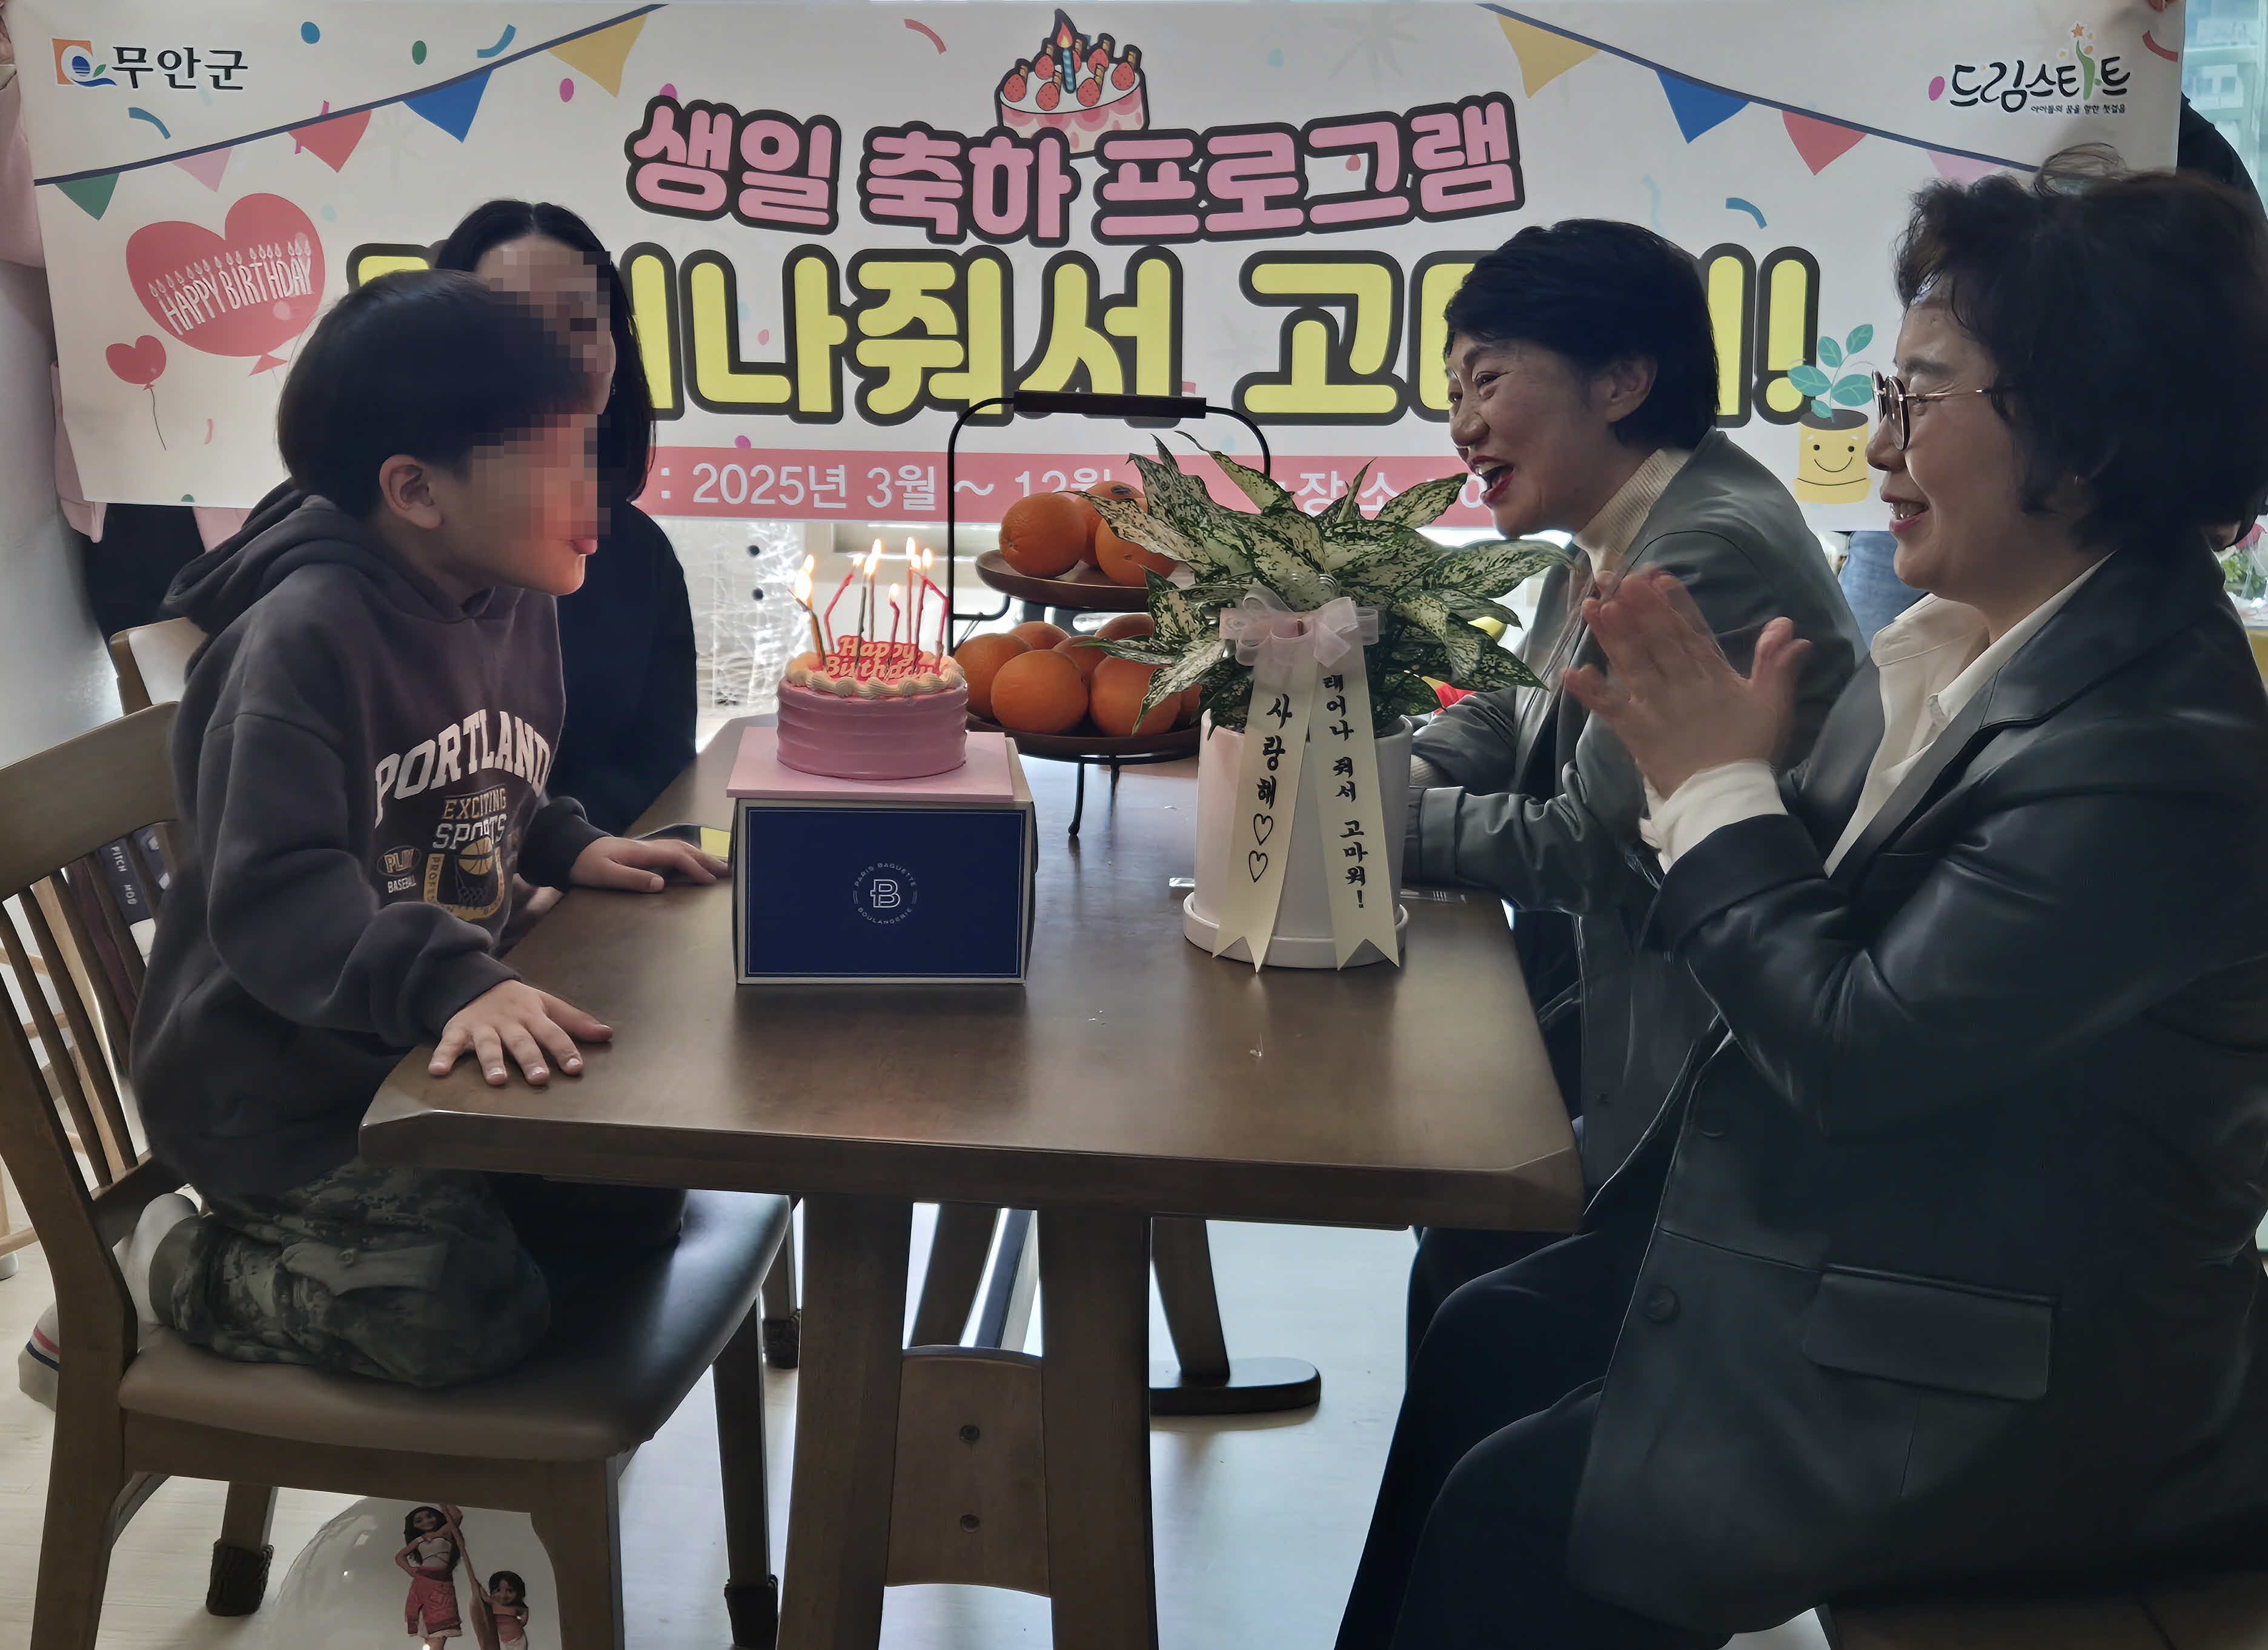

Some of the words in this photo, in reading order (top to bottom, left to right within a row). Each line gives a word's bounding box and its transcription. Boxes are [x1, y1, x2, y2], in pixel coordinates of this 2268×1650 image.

[111, 46, 248, 90] 무안군
[1949, 40, 2130, 113] 드림스타트
[625, 95, 841, 235] 생일
[857, 121, 1081, 247] 축하
[1091, 91, 1525, 245] 프로그램
[156, 270, 226, 336] HAPPY
[218, 256, 313, 310] BIRTHDAY
[692, 463, 847, 509] 2025년
[867, 465, 935, 511] 3월
[374, 709, 551, 829] PORTLAND
[1256, 693, 1293, 810] 사랑해
[442, 787, 506, 820] EXCITING
[1323, 674, 1354, 741] 태어나
[1339, 820, 1368, 909] 고마워!
[854, 865, 874, 887] PARIS
[878, 863, 917, 887] BAGUETTE
[858, 907, 912, 924] BOULANGERIE
